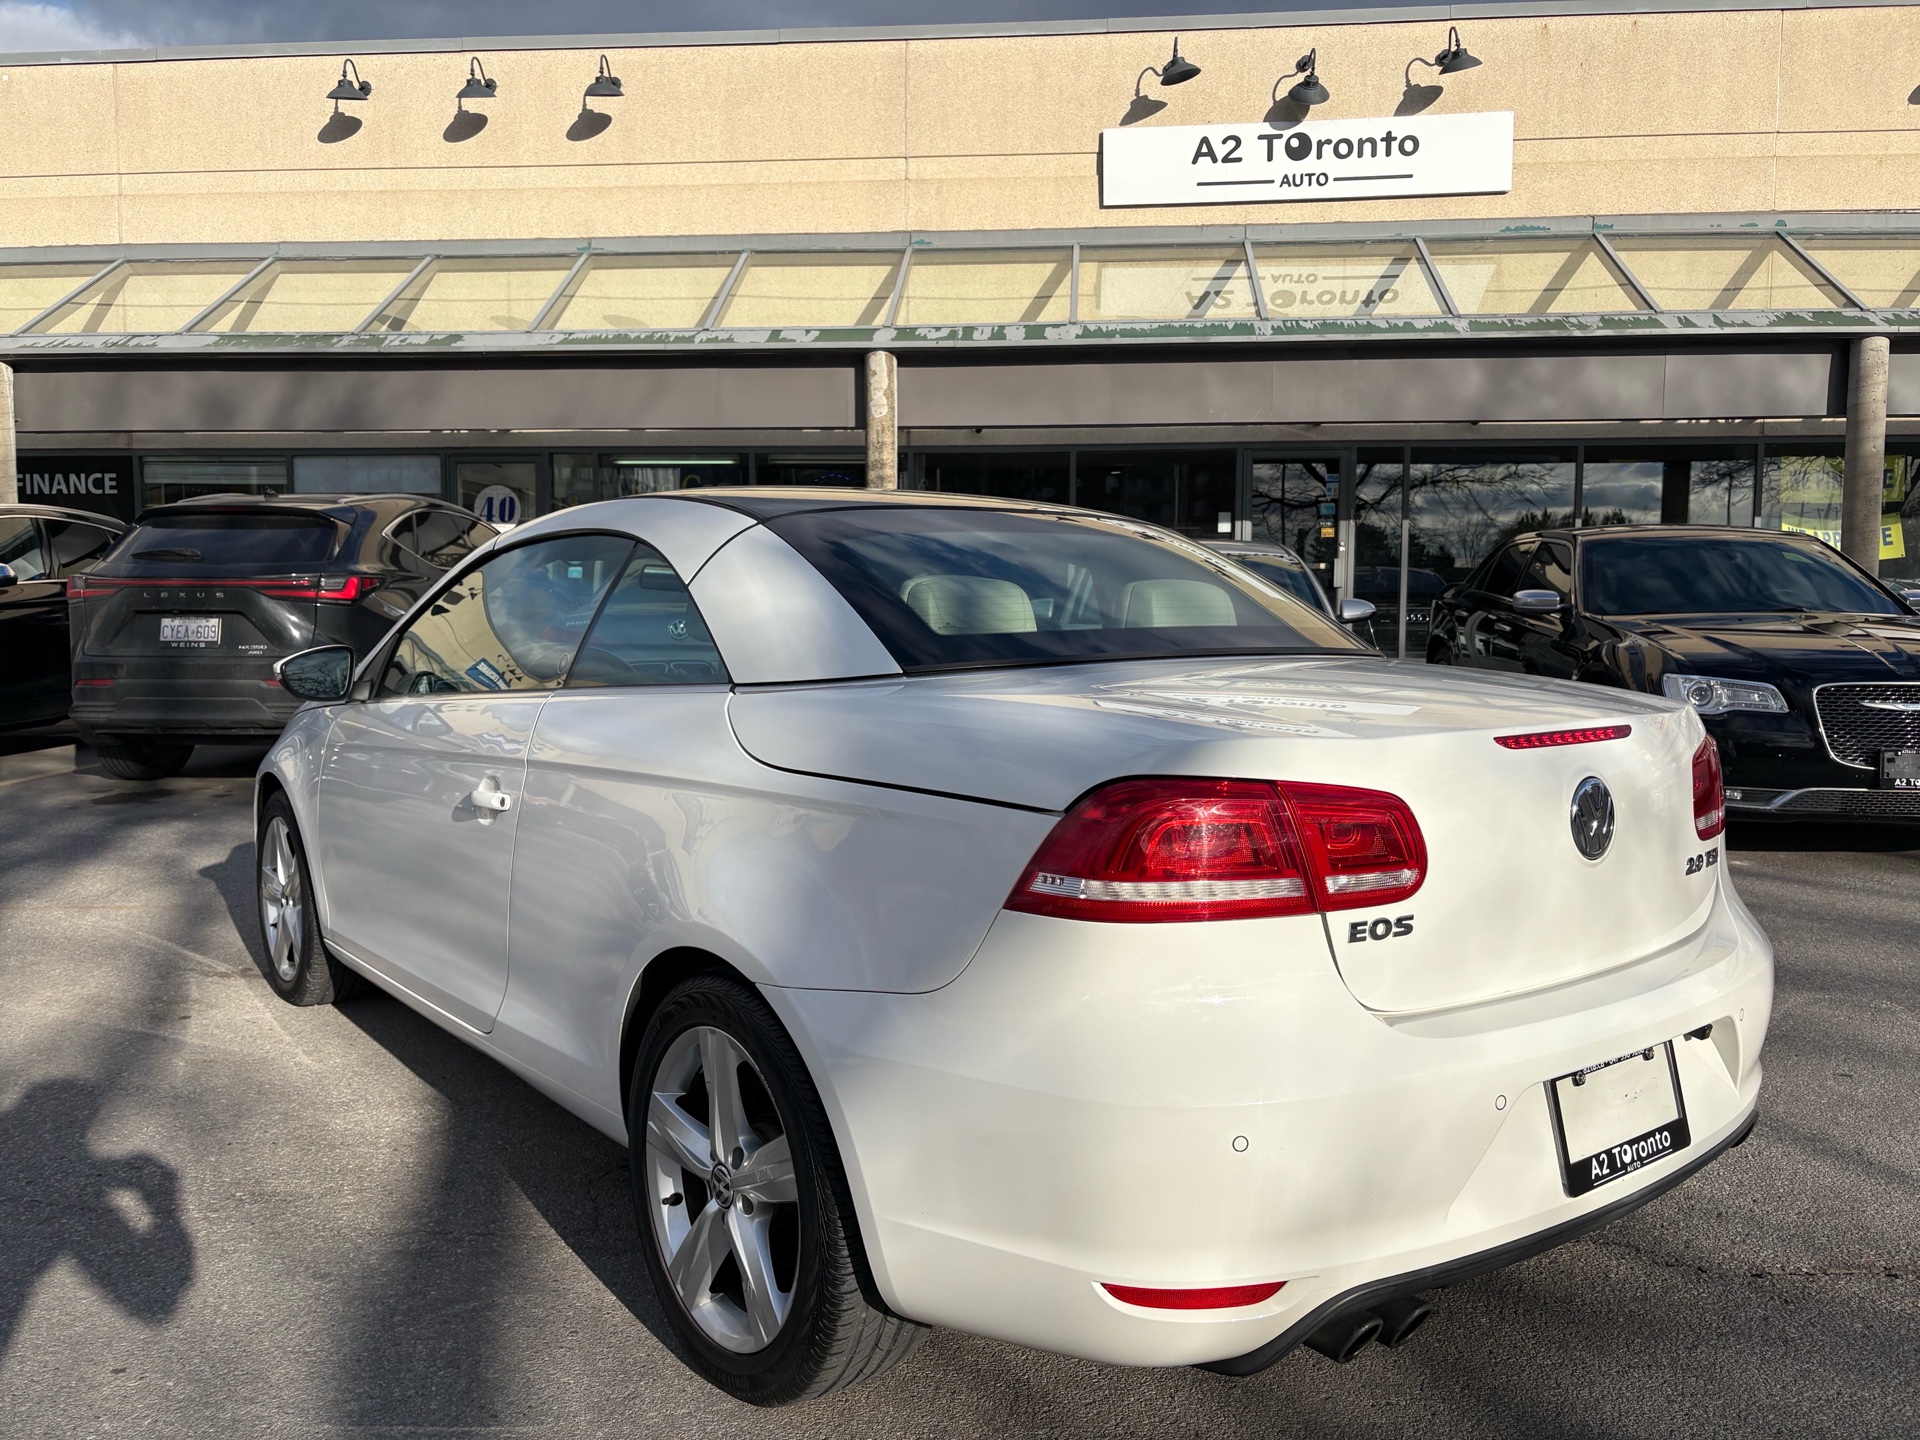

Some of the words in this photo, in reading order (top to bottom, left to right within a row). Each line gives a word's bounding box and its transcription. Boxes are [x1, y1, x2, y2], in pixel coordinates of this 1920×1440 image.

[1191, 134, 1243, 165] A2
[1279, 172, 1329, 188] AUTO
[479, 496, 516, 523] 40
[195, 625, 217, 639] 609
[1894, 778, 1907, 786] A2
[1347, 914, 1414, 944] EOS
[1591, 1153, 1610, 1180] A2
[1627, 1162, 1641, 1172] AUTO
